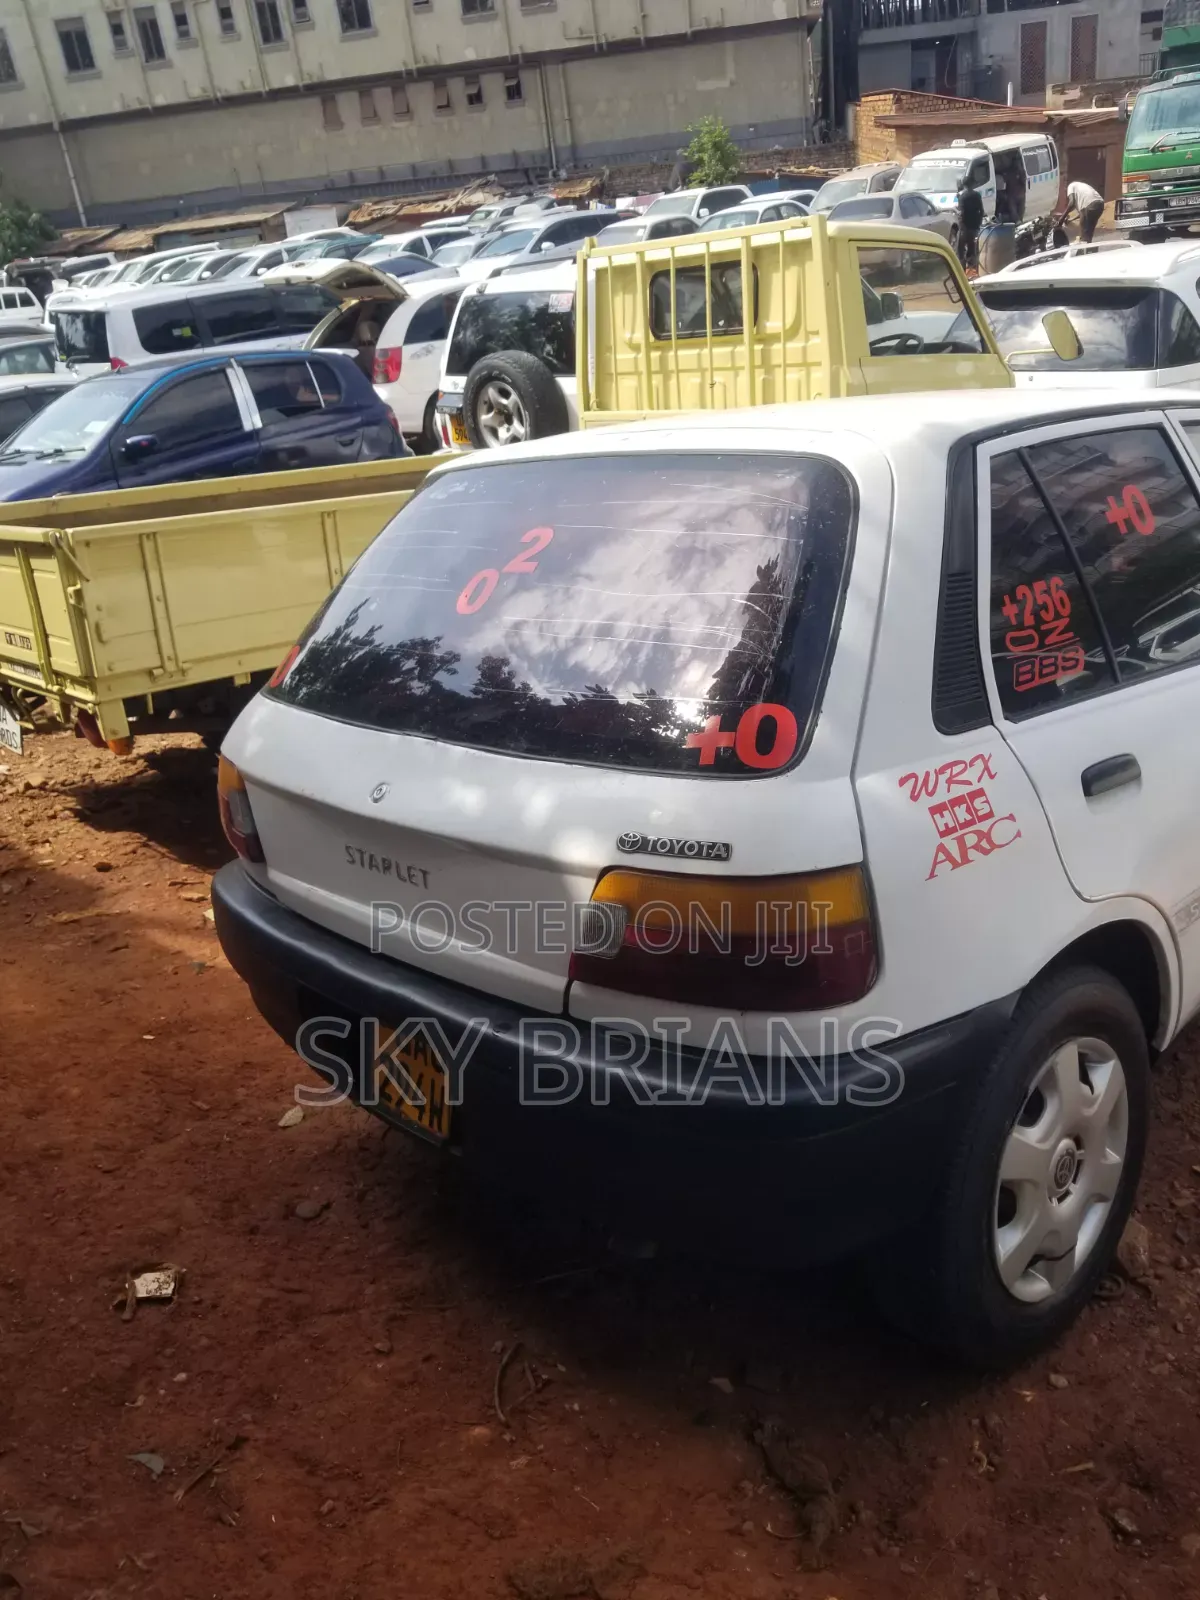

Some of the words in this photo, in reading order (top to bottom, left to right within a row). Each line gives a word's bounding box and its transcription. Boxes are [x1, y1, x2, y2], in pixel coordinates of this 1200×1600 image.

[1001, 575, 1072, 627] +256
[1014, 646, 1084, 691] BBS
[898, 752, 998, 802] WRX
[929, 788, 995, 838] HKS
[344, 844, 431, 890] STARLET
[646, 835, 728, 858] TOYOTA
[924, 813, 1022, 881] ARC
